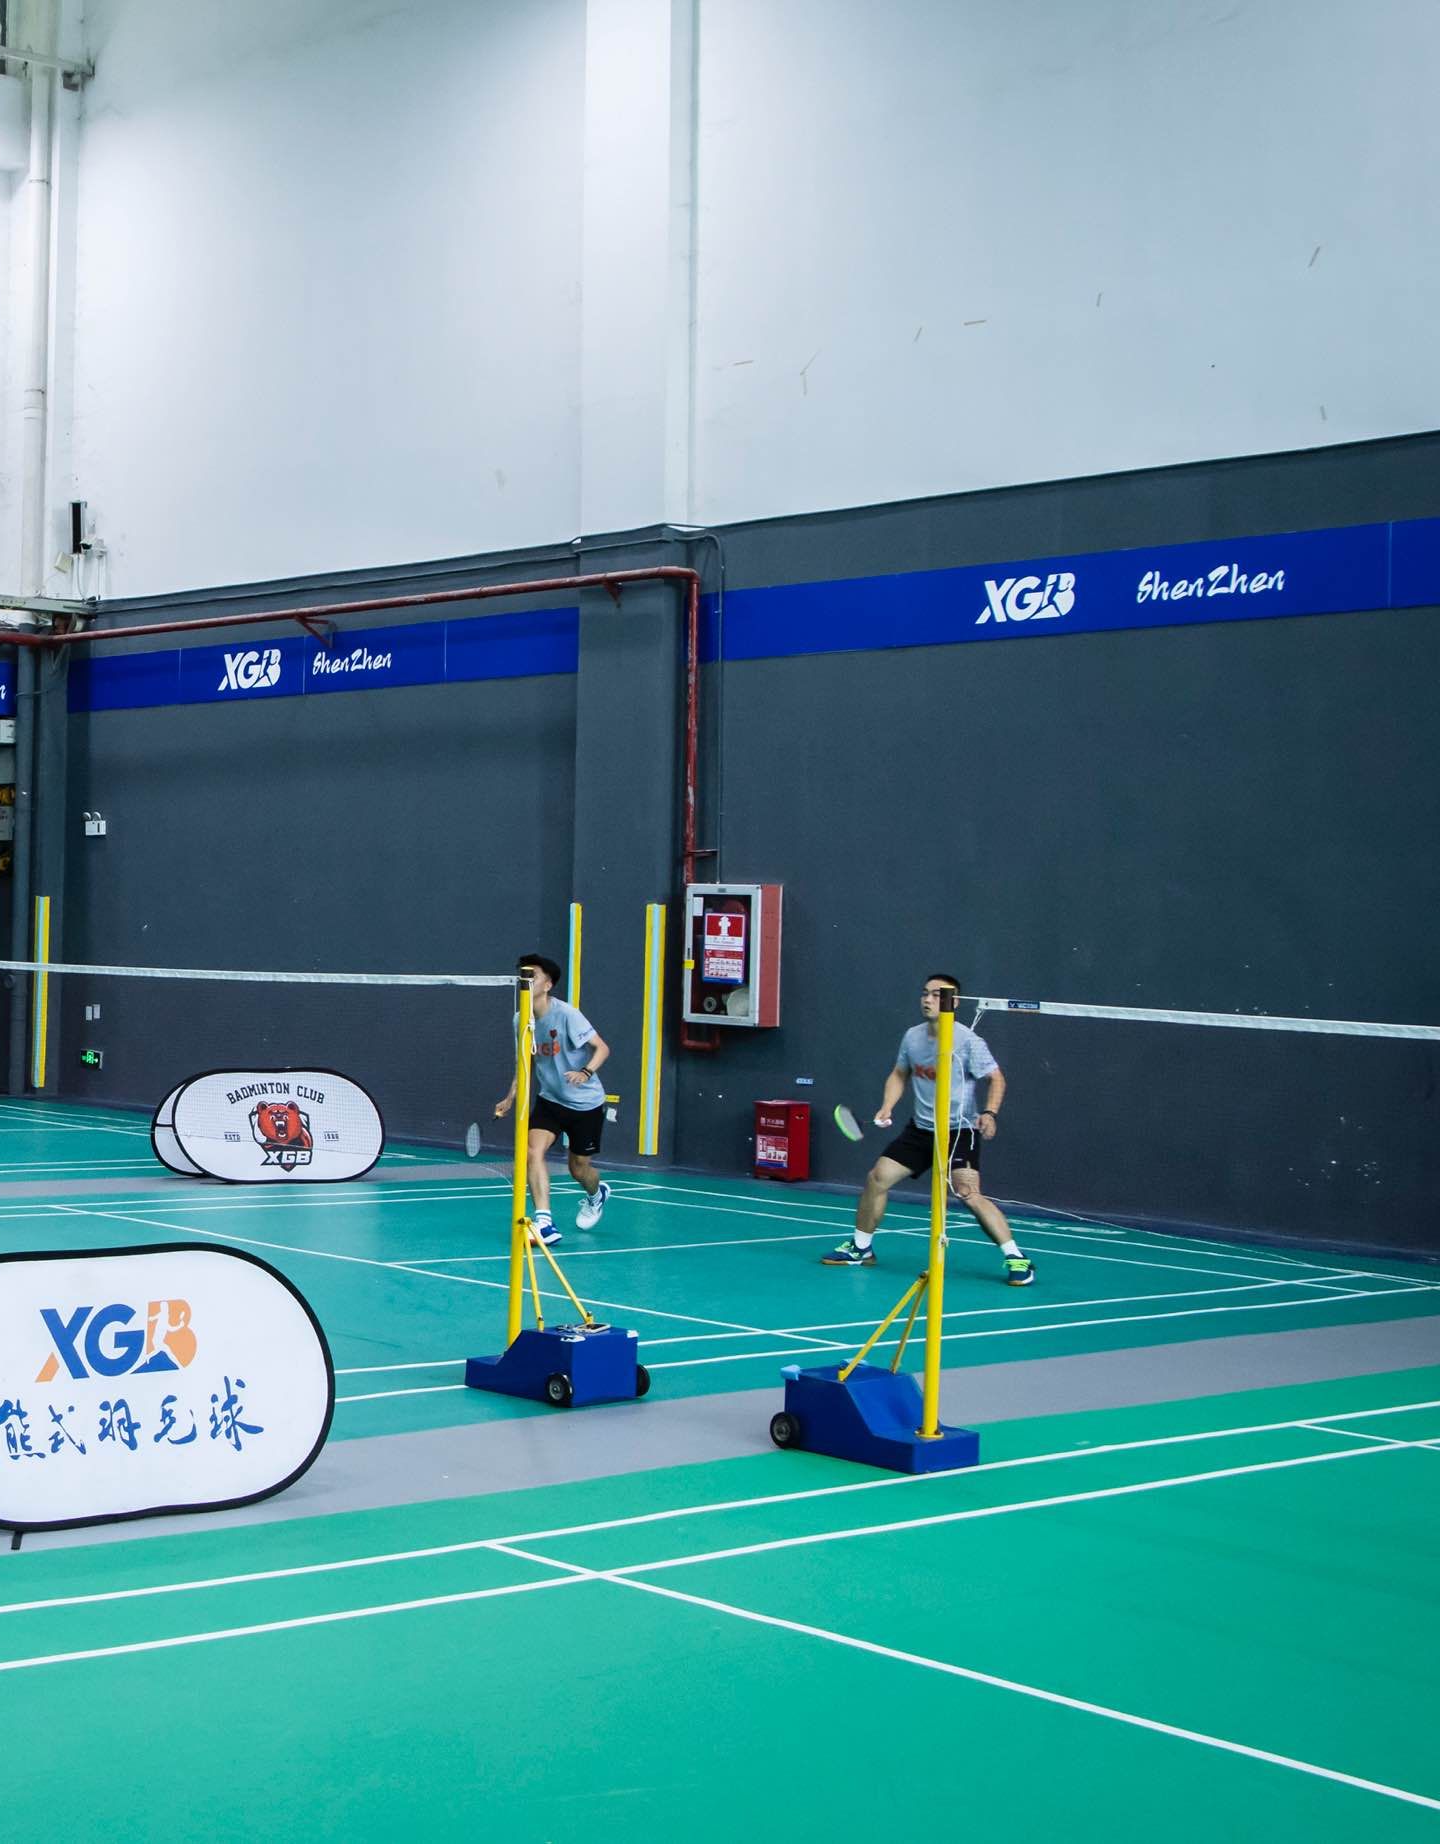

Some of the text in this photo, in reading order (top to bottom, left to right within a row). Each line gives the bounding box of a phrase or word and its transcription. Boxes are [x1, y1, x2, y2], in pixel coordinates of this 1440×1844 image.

[975, 572, 1076, 625] XGB
[217, 648, 282, 691] XGB
[226, 1083, 325, 1104] BADMINTON CLUB
[266, 1151, 310, 1164] XGB
[35, 1299, 198, 1383] XGB
